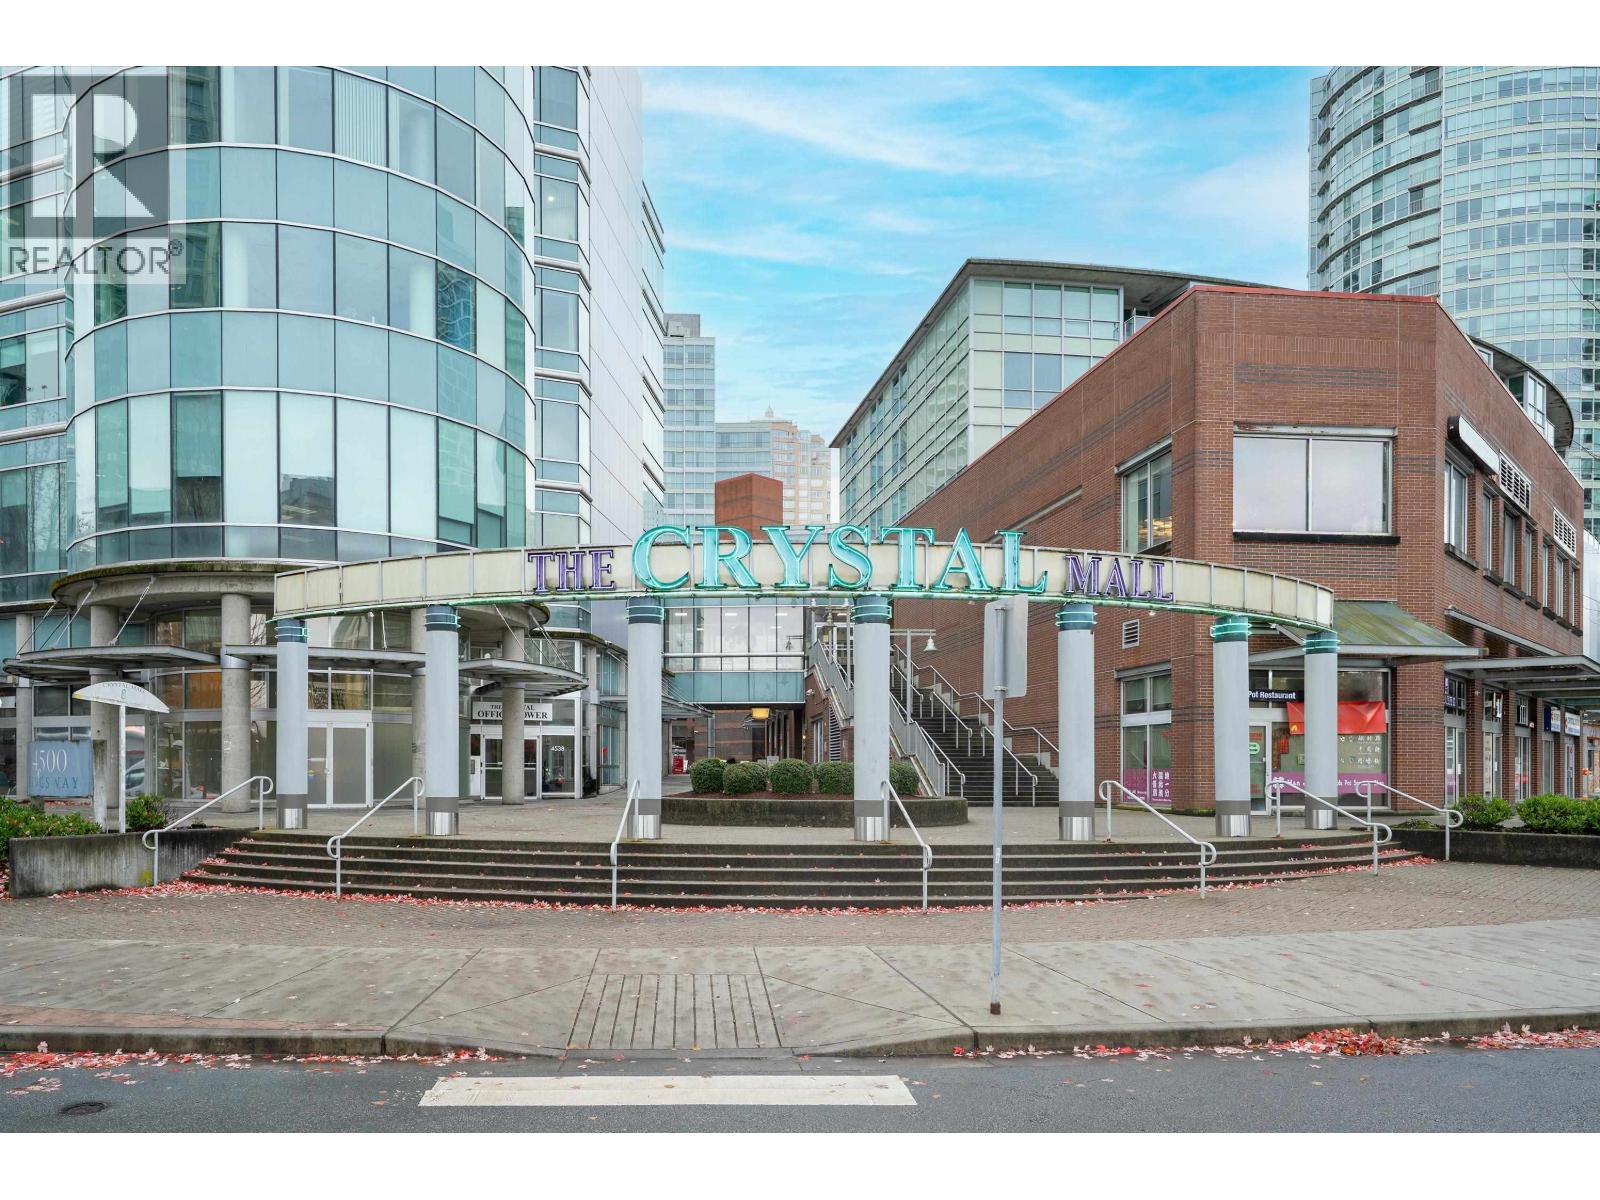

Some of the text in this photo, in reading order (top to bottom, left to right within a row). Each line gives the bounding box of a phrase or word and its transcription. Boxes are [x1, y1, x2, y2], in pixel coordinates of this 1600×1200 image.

[528, 525, 1174, 601] THE CRYSTAL MALL
[1259, 691, 1296, 700] Restaurant
[477, 710, 548, 719] OFFIC OWER
[32, 749, 67, 772] 4500
